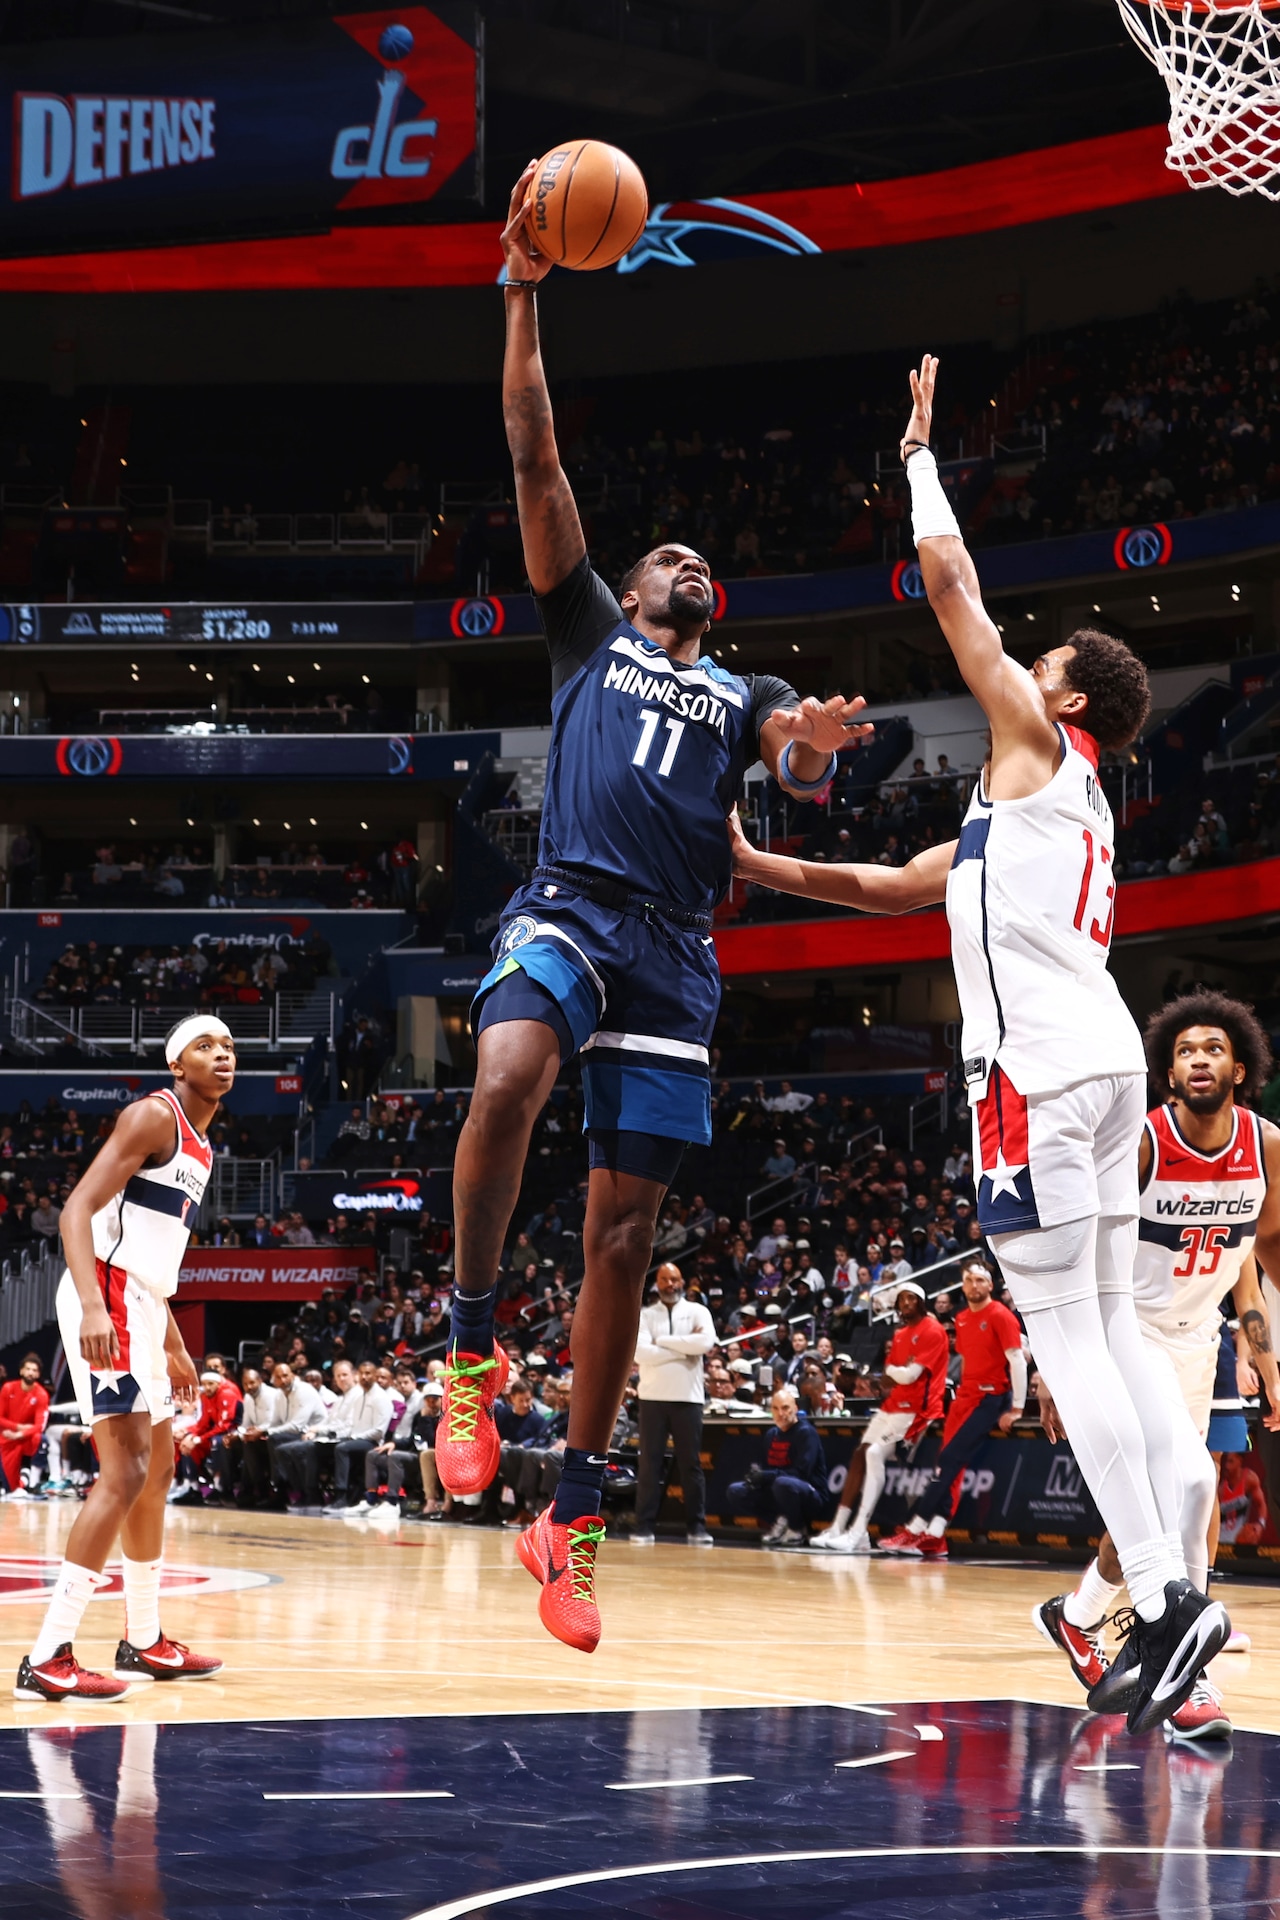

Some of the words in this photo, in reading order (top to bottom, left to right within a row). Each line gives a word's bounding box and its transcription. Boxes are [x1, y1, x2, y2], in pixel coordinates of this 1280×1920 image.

[14, 92, 216, 200] DEFENSE
[535, 150, 572, 231] Wilson
[202, 619, 271, 641] $1,280
[318, 621, 339, 634] PM
[603, 660, 727, 737] MINNESOTA
[630, 708, 686, 778] 11
[1072, 828, 1115, 949] 13
[41, 914, 59, 926] 104
[280, 1078, 298, 1090] 104
[1156, 1190, 1256, 1216] wizards
[1173, 1227, 1230, 1278] 35
[178, 1267, 265, 1283] SHINGTON
[271, 1267, 358, 1284] WIZARDS
